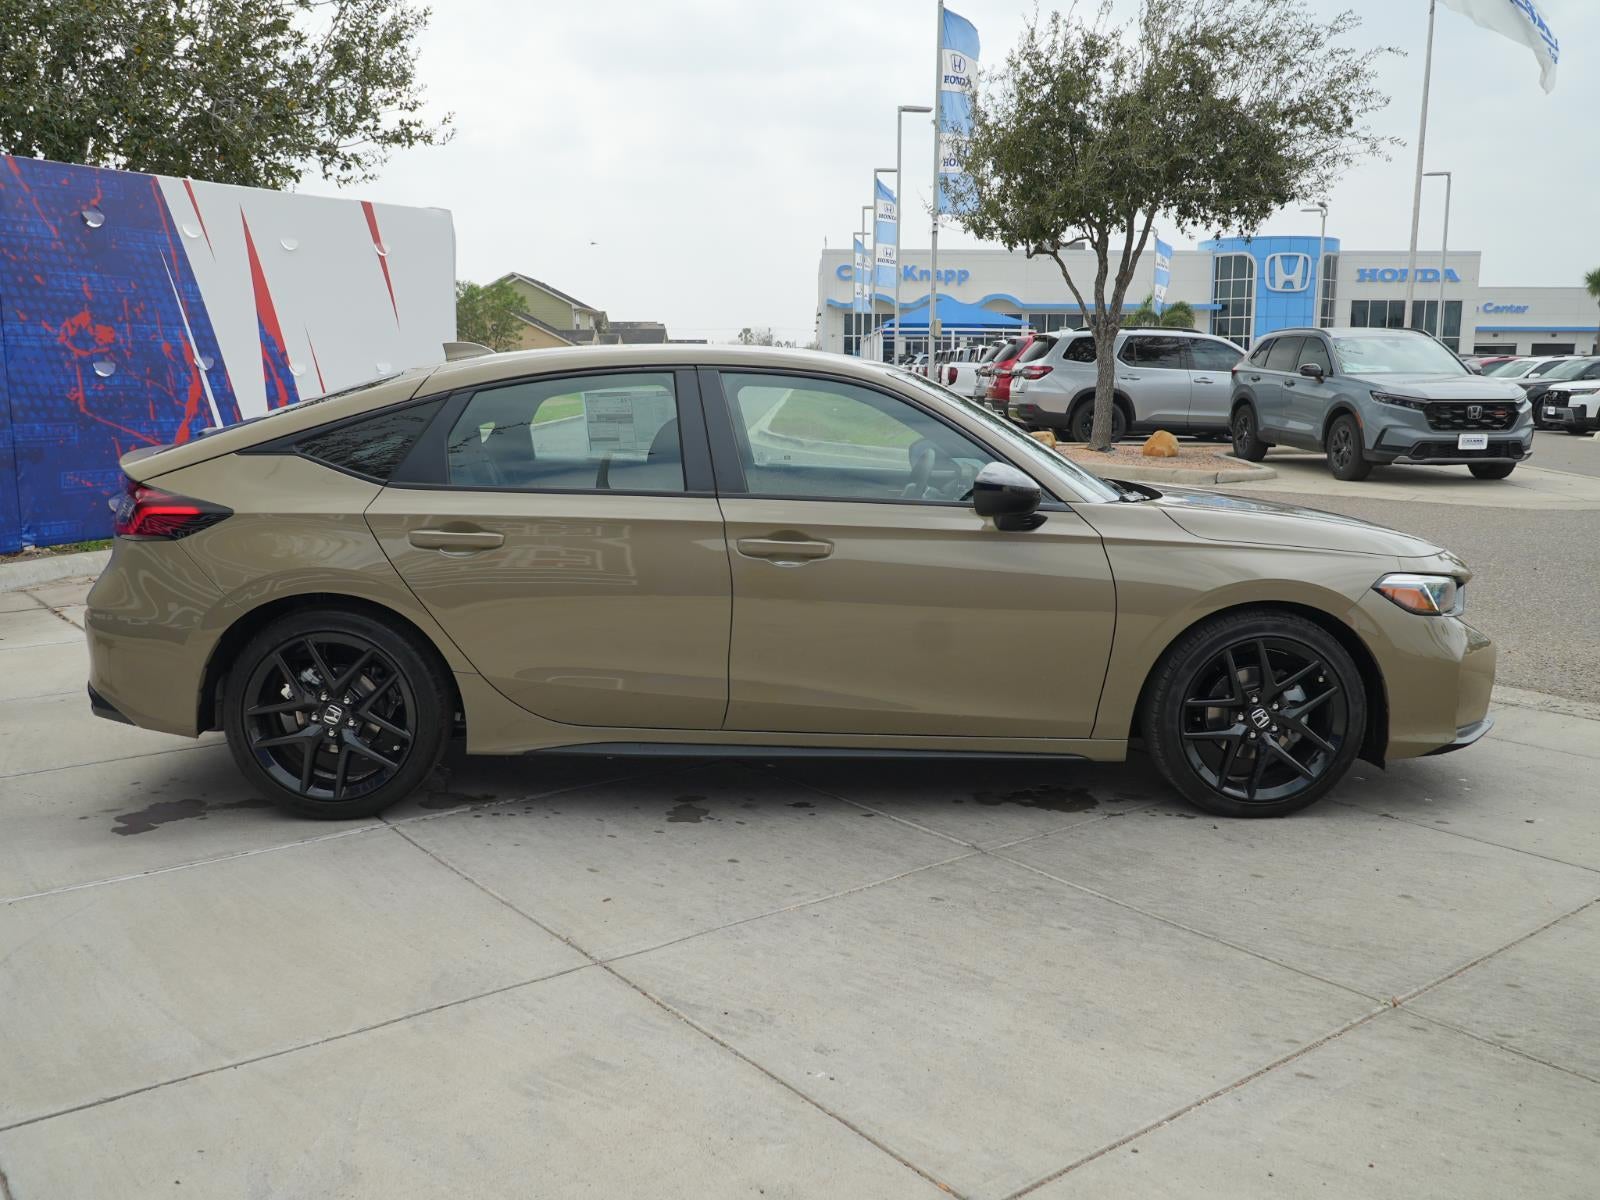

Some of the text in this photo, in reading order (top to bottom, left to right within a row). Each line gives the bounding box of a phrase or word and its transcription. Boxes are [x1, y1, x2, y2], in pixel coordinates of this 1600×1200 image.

[944, 75, 972, 89] HONDA
[1356, 268, 1461, 283] HONDA
[1482, 302, 1530, 314] Center
